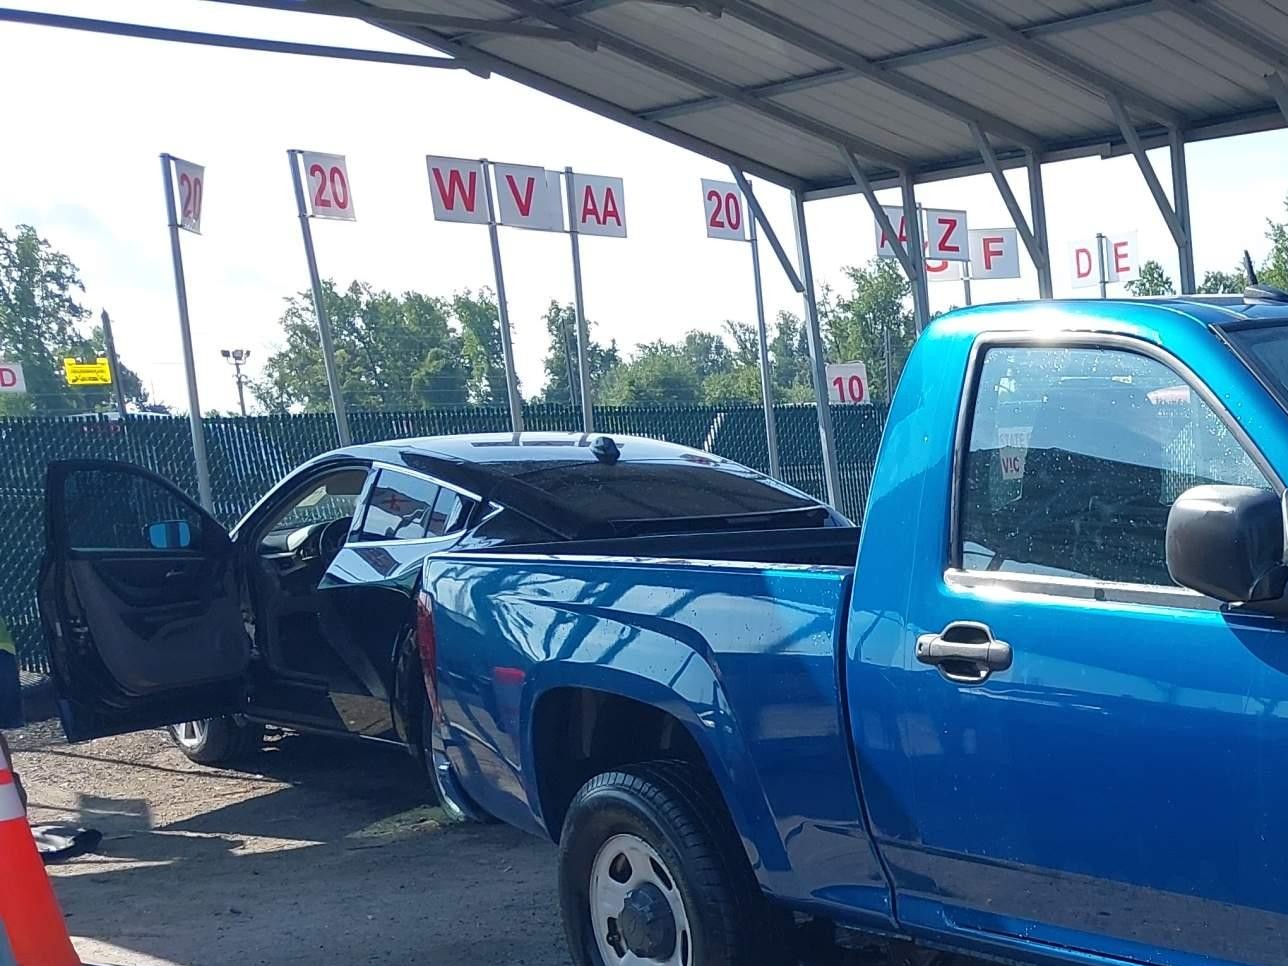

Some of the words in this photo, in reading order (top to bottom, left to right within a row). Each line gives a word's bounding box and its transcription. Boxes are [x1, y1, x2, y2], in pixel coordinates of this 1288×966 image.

[180, 172, 202, 221] 20
[310, 164, 348, 209] 20
[432, 167, 477, 213] W
[505, 174, 535, 217] V
[582, 185, 622, 227] AA
[707, 190, 741, 230] 20
[938, 218, 960, 252] Z
[982, 237, 1004, 270] F
[1075, 248, 1092, 278] D
[1113, 241, 1130, 272] E
[833, 375, 864, 403] 10
